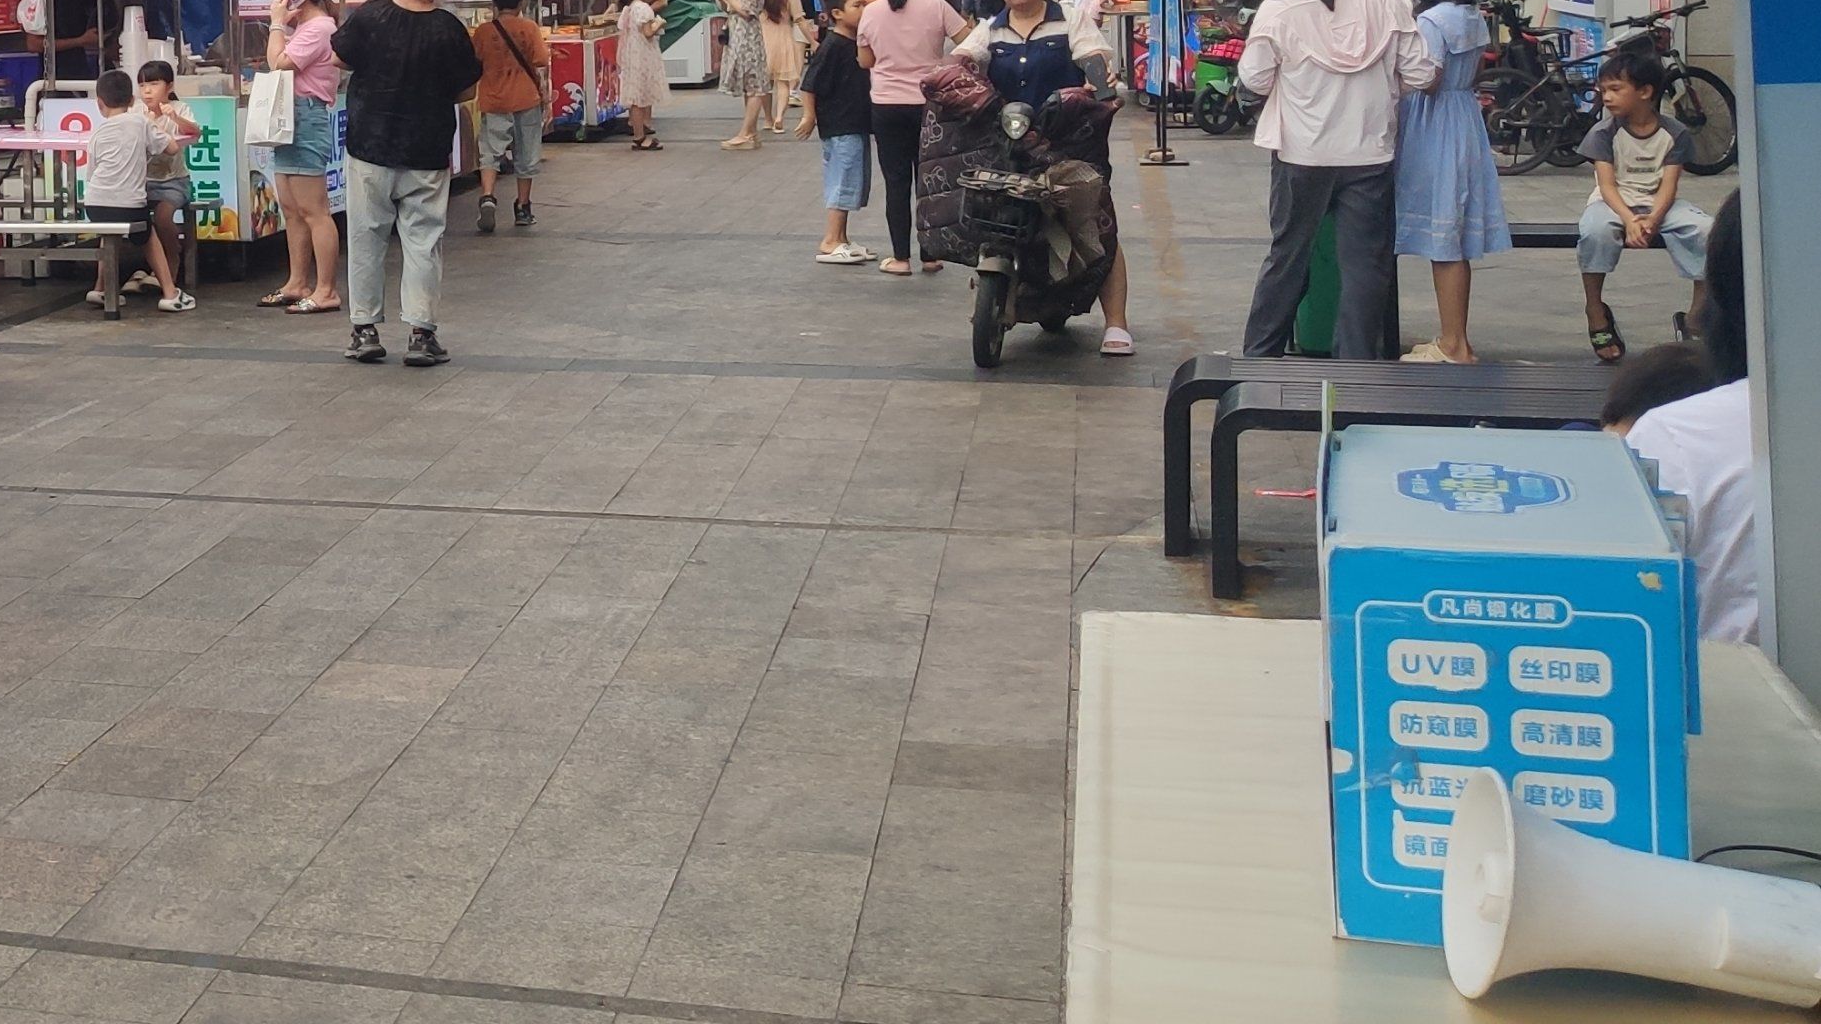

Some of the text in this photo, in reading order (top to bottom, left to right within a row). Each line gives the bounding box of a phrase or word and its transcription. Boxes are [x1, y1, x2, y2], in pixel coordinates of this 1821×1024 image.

[1439, 597, 1558, 622] 凡尚钢化膜
[1400, 655, 1601, 684] UV膜 丝印膜
[1399, 713, 1602, 747] 防窥膜 高清膜
[1523, 784, 1604, 811] 磨砂膜
